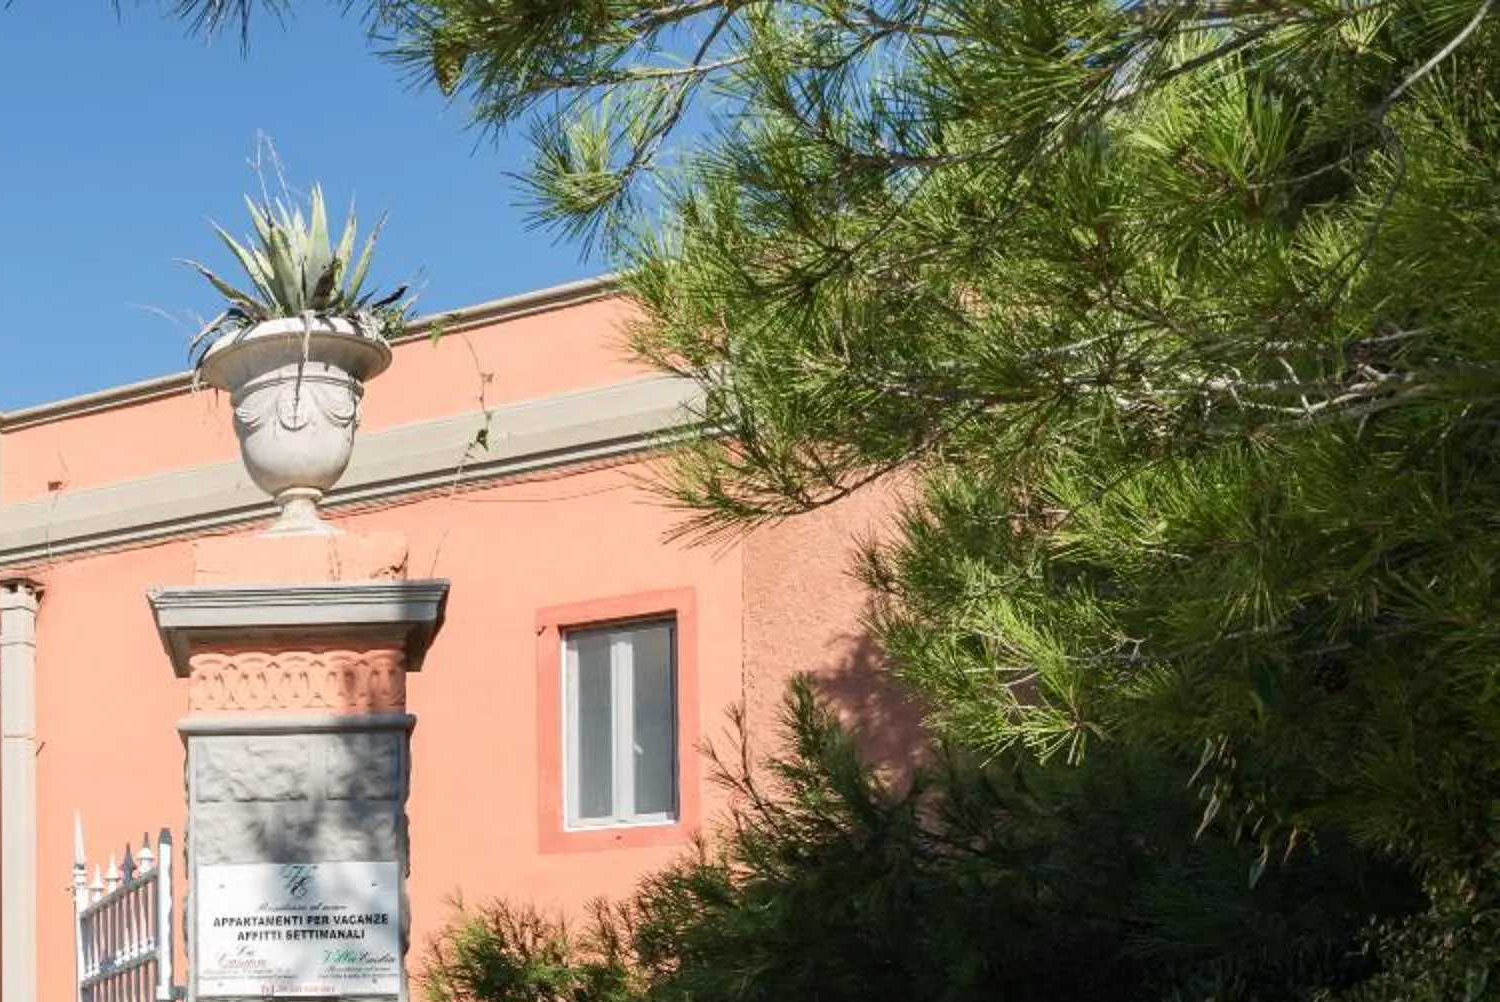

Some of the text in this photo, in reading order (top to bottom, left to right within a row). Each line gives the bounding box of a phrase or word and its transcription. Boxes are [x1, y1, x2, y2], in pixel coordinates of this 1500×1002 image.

[213, 913, 389, 927] APPARTAMENTI PER VACANZE
[237, 929, 366, 941] AFFITTI SETTIMANALI
